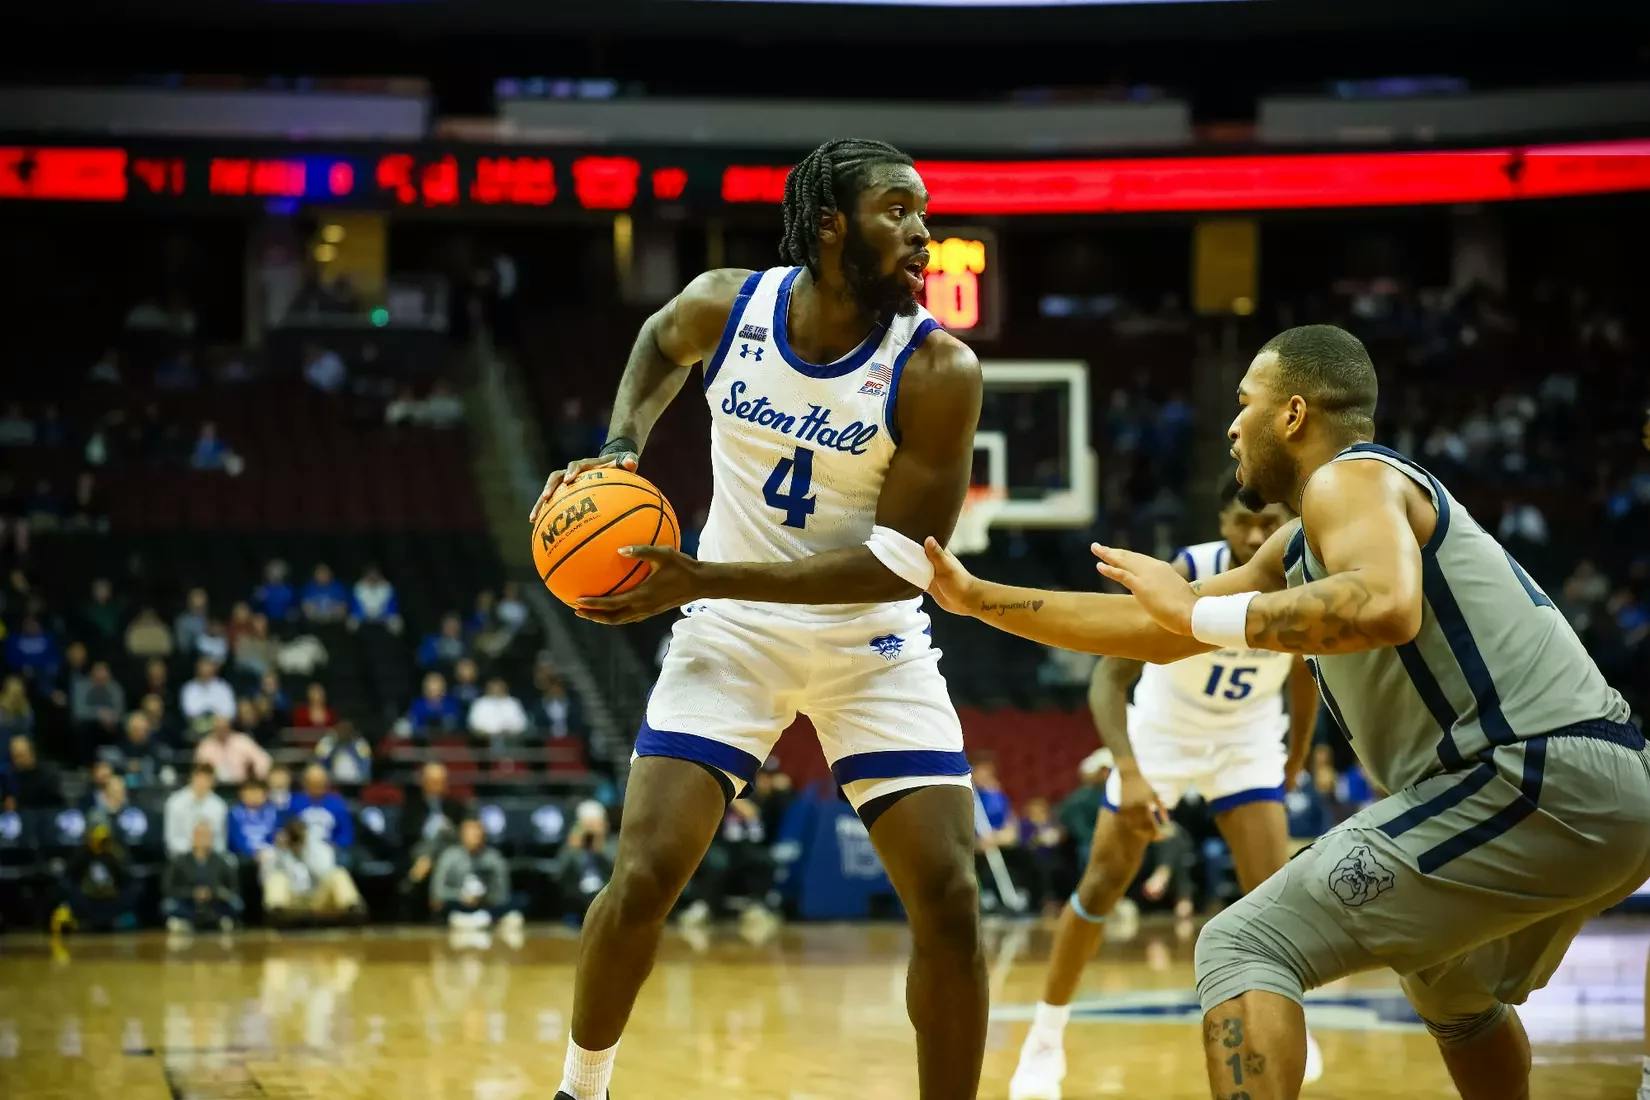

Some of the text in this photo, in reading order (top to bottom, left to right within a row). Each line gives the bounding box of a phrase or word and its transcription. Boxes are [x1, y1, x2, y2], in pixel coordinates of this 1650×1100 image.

[738, 330, 767, 342] CHANGE
[743, 324, 769, 335] BE THE
[859, 385, 887, 397] EAST
[864, 380, 884, 390] BIG
[721, 381, 879, 456] Seton Hall
[762, 446, 817, 530] 4
[541, 496, 598, 552] NCAA
[1204, 664, 1258, 700] 15
